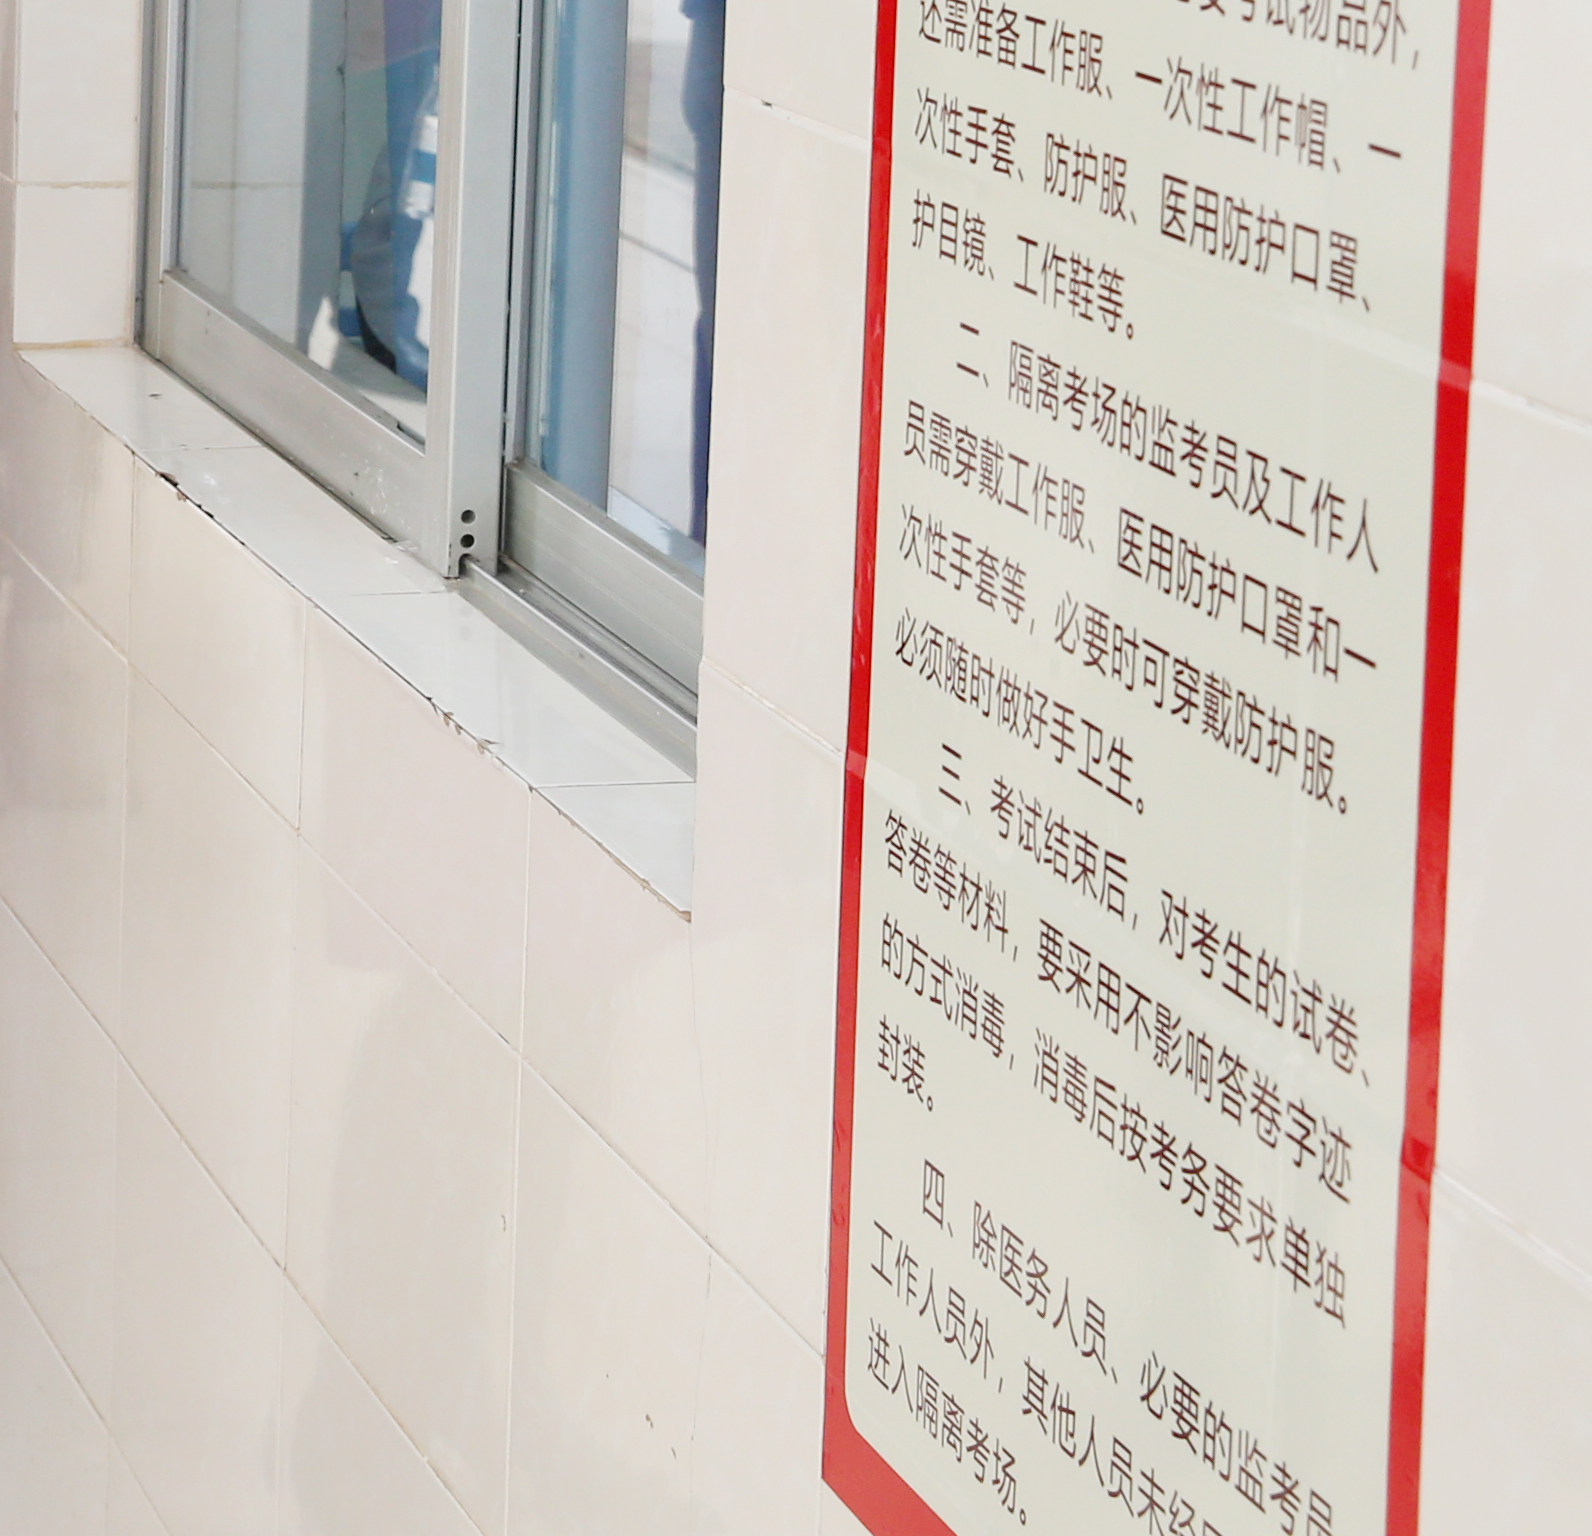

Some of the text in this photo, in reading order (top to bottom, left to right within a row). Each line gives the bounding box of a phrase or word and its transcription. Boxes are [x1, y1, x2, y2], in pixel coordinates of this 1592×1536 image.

[913, 189, 1135, 341] 护目镜、工作鞋等。
[904, 399, 1377, 683] 员需穿戴工作服、医用防护口罩和一
[956, 322, 1380, 574] 二、隔离考场的监考员及工作人
[895, 608, 1145, 816] 必须随时做好手卫生。
[877, 1014, 934, 1112] 封装。
[867, 1317, 1028, 1526] 进入隔离考场。
